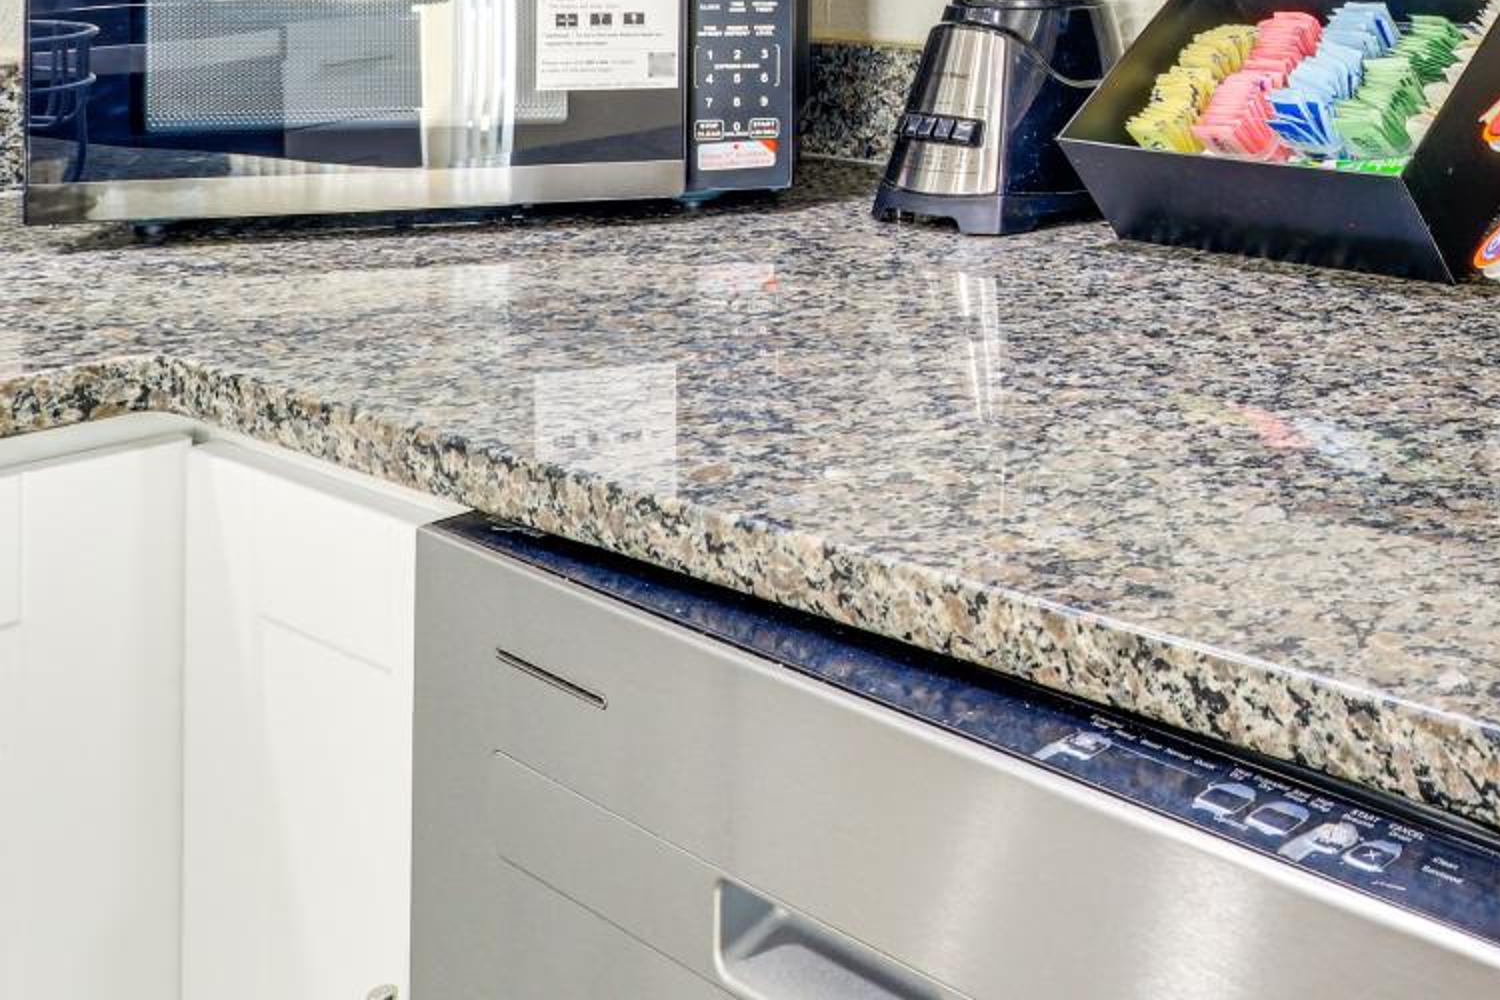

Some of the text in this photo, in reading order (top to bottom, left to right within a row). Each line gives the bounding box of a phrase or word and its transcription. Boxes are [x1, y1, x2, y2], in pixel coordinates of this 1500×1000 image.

[707, 48, 769, 60] 1 2 3
[705, 73, 714, 85] 4
[760, 72, 769, 83] 6
[705, 97, 713, 109] 7
[733, 121, 740, 131] 0
[1351, 808, 1381, 823] START
[1388, 823, 1424, 841] CANCEL
